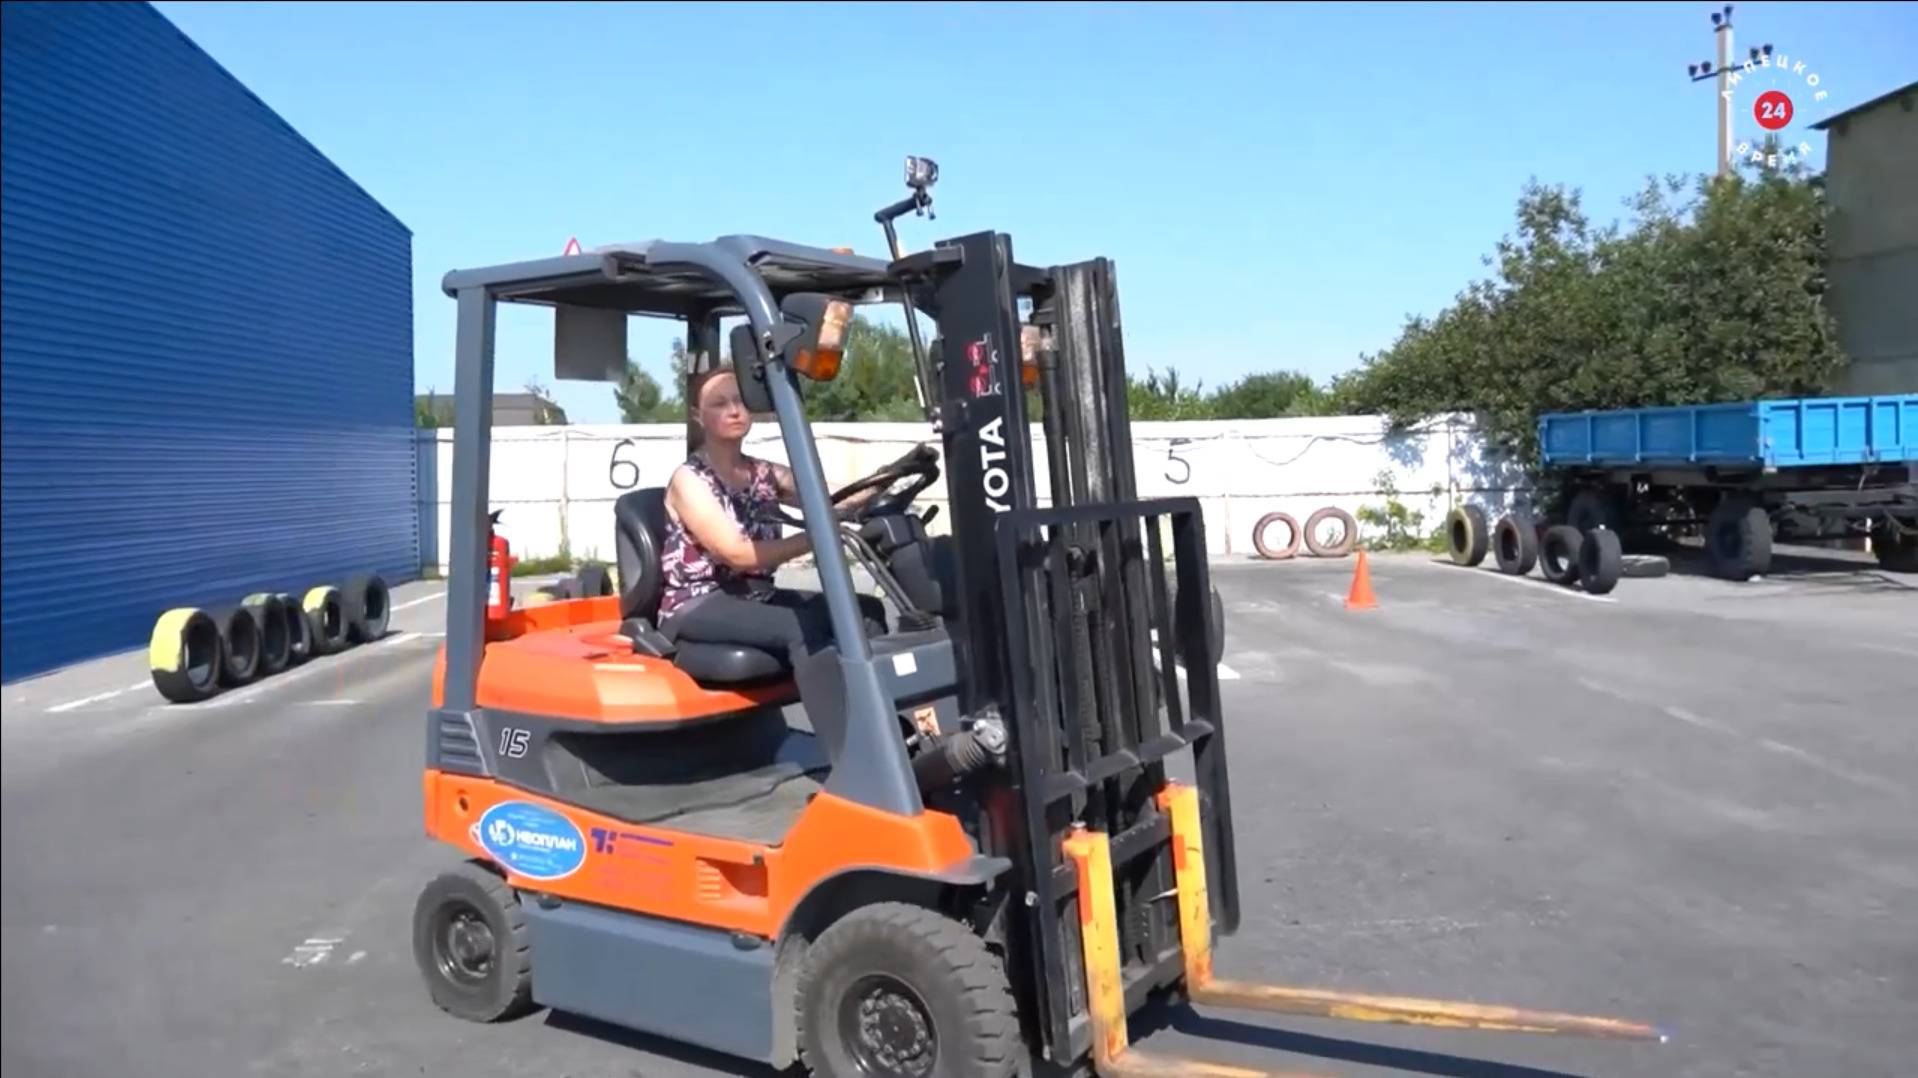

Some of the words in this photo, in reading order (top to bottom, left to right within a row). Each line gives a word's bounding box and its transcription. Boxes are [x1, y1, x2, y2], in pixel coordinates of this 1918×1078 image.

[609, 438, 640, 490] 6
[1164, 438, 1192, 485] 5
[499, 727, 531, 758] 15
[516, 829, 577, 852] НЕОПЛАН
